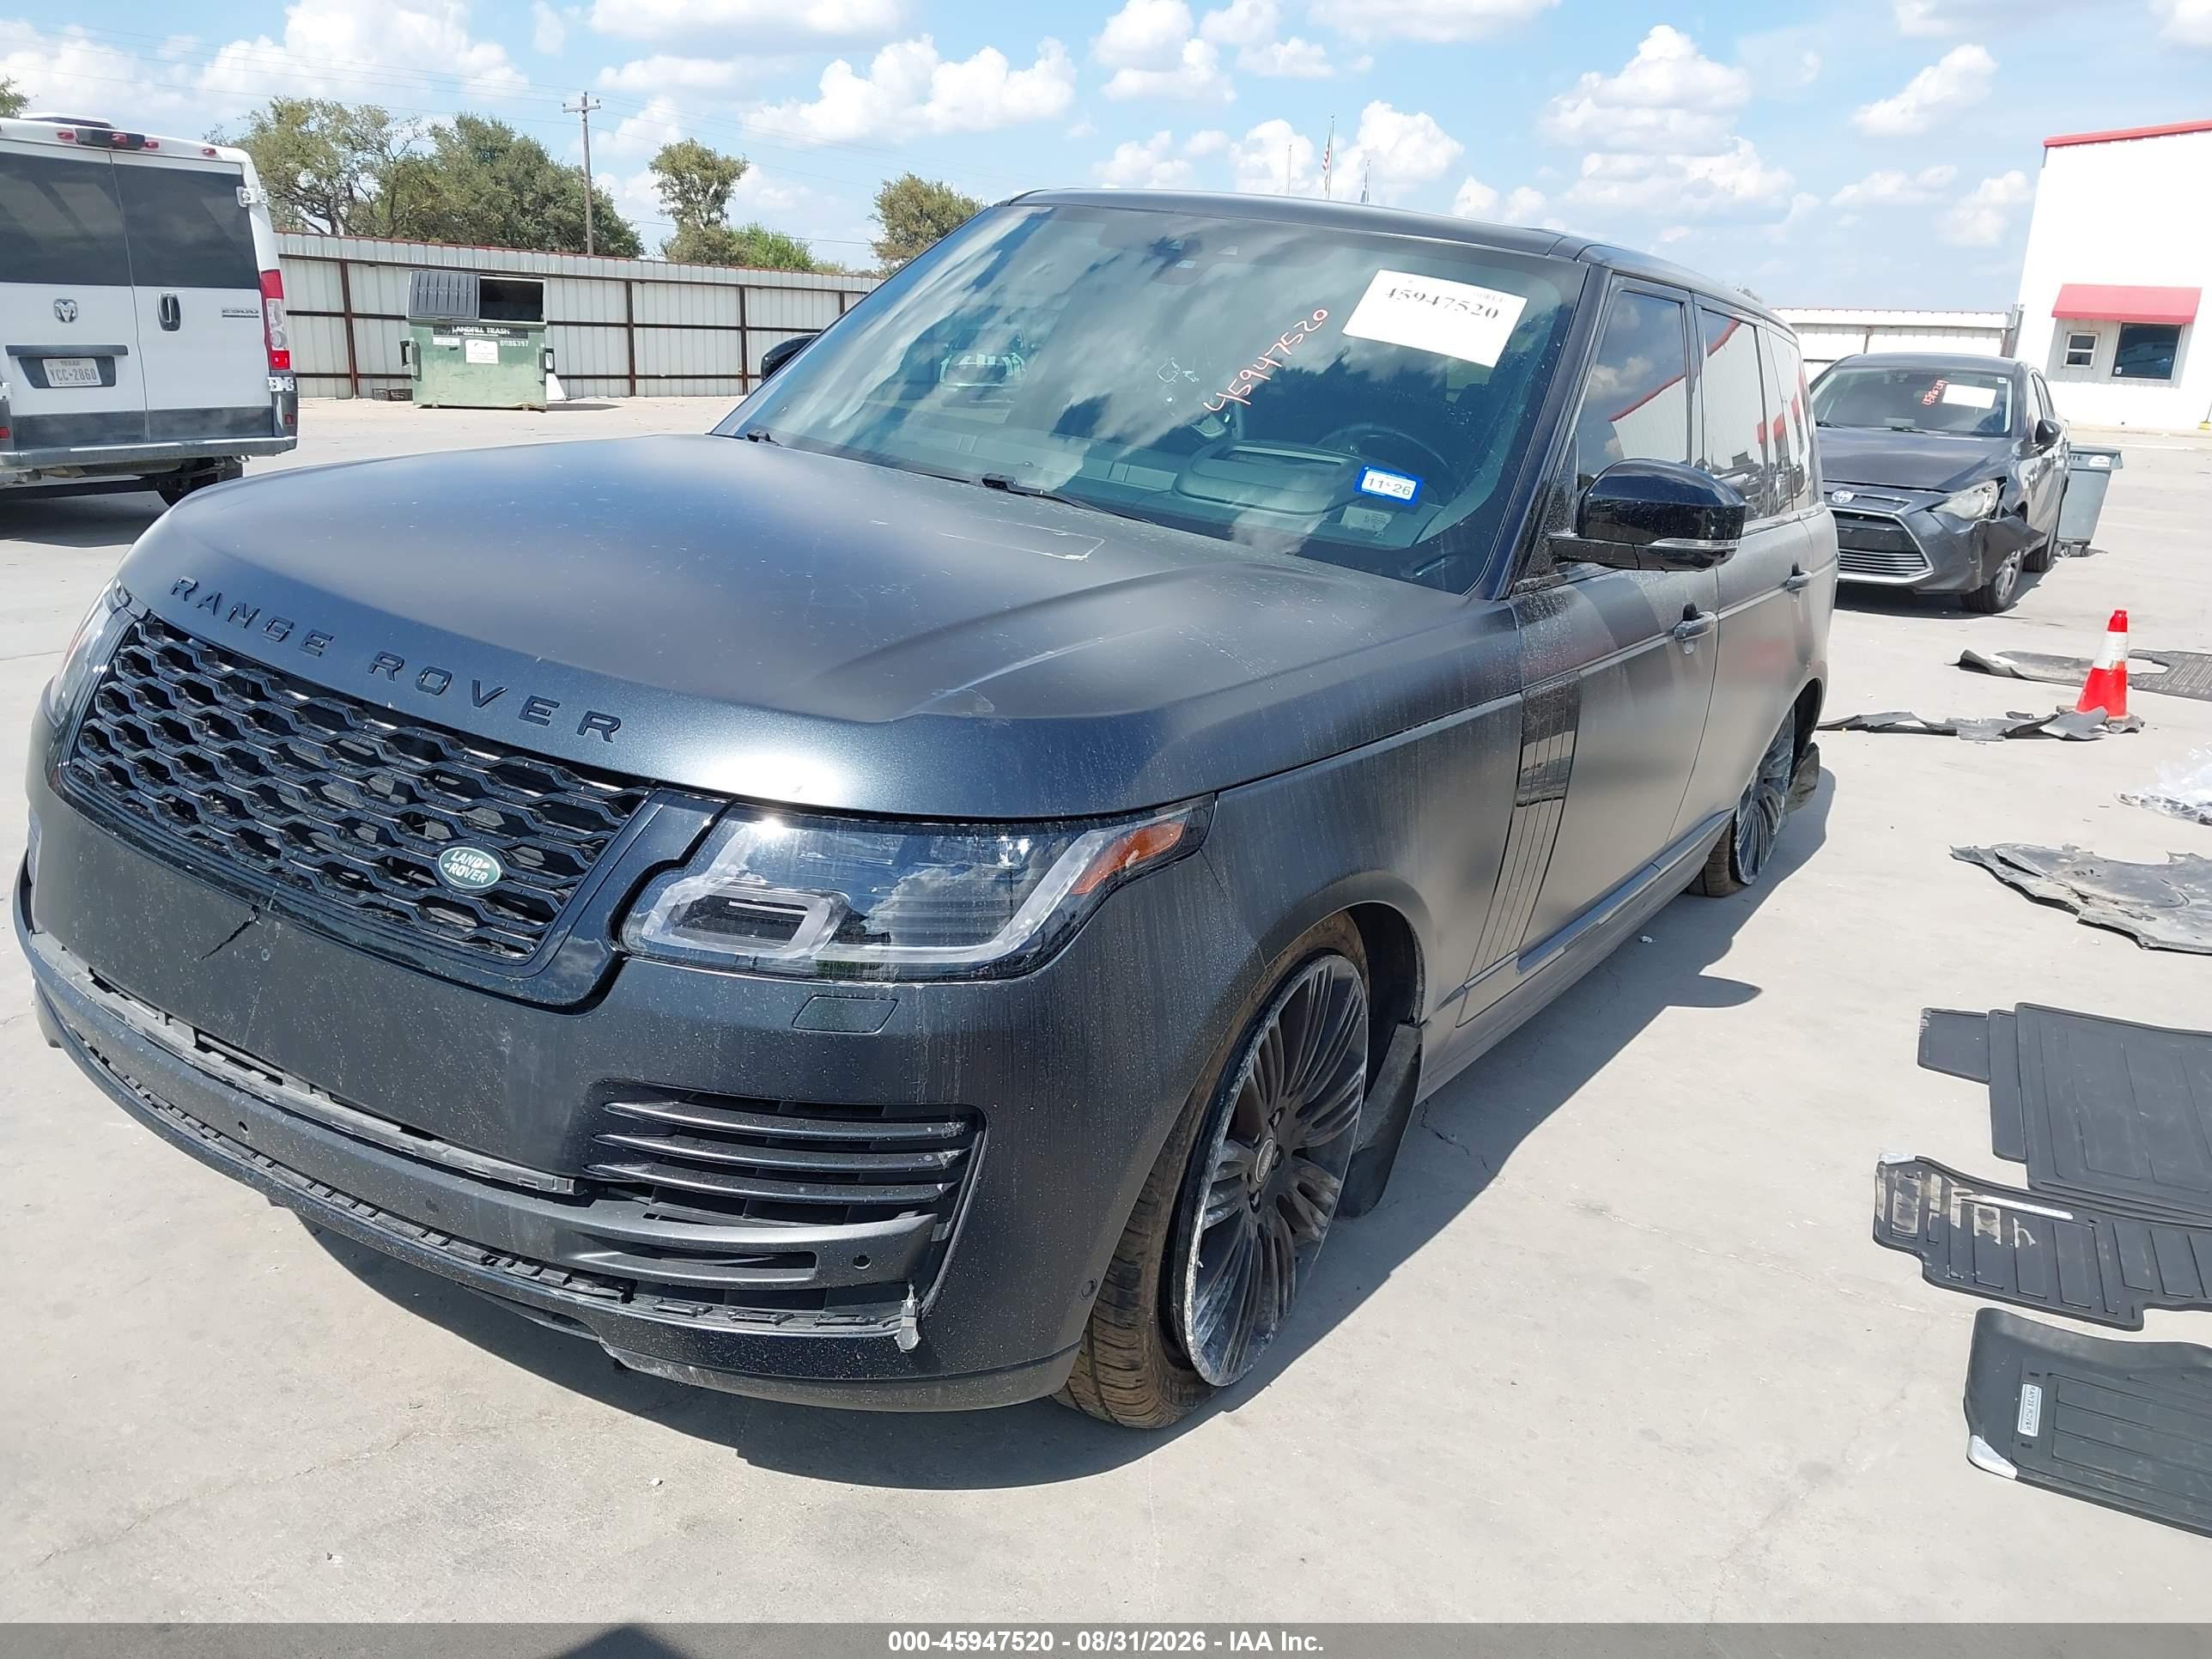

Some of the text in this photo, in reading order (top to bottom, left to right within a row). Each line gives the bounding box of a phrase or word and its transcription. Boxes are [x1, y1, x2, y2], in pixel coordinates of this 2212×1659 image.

[1386, 288, 1499, 319] 45947520
[1203, 309, 1328, 410] 45947520
[1392, 483, 1412, 495] 26
[170, 575, 622, 744] RANGE ROVER
[451, 850, 483, 868] LAND
[447, 862, 489, 884] ROVER
